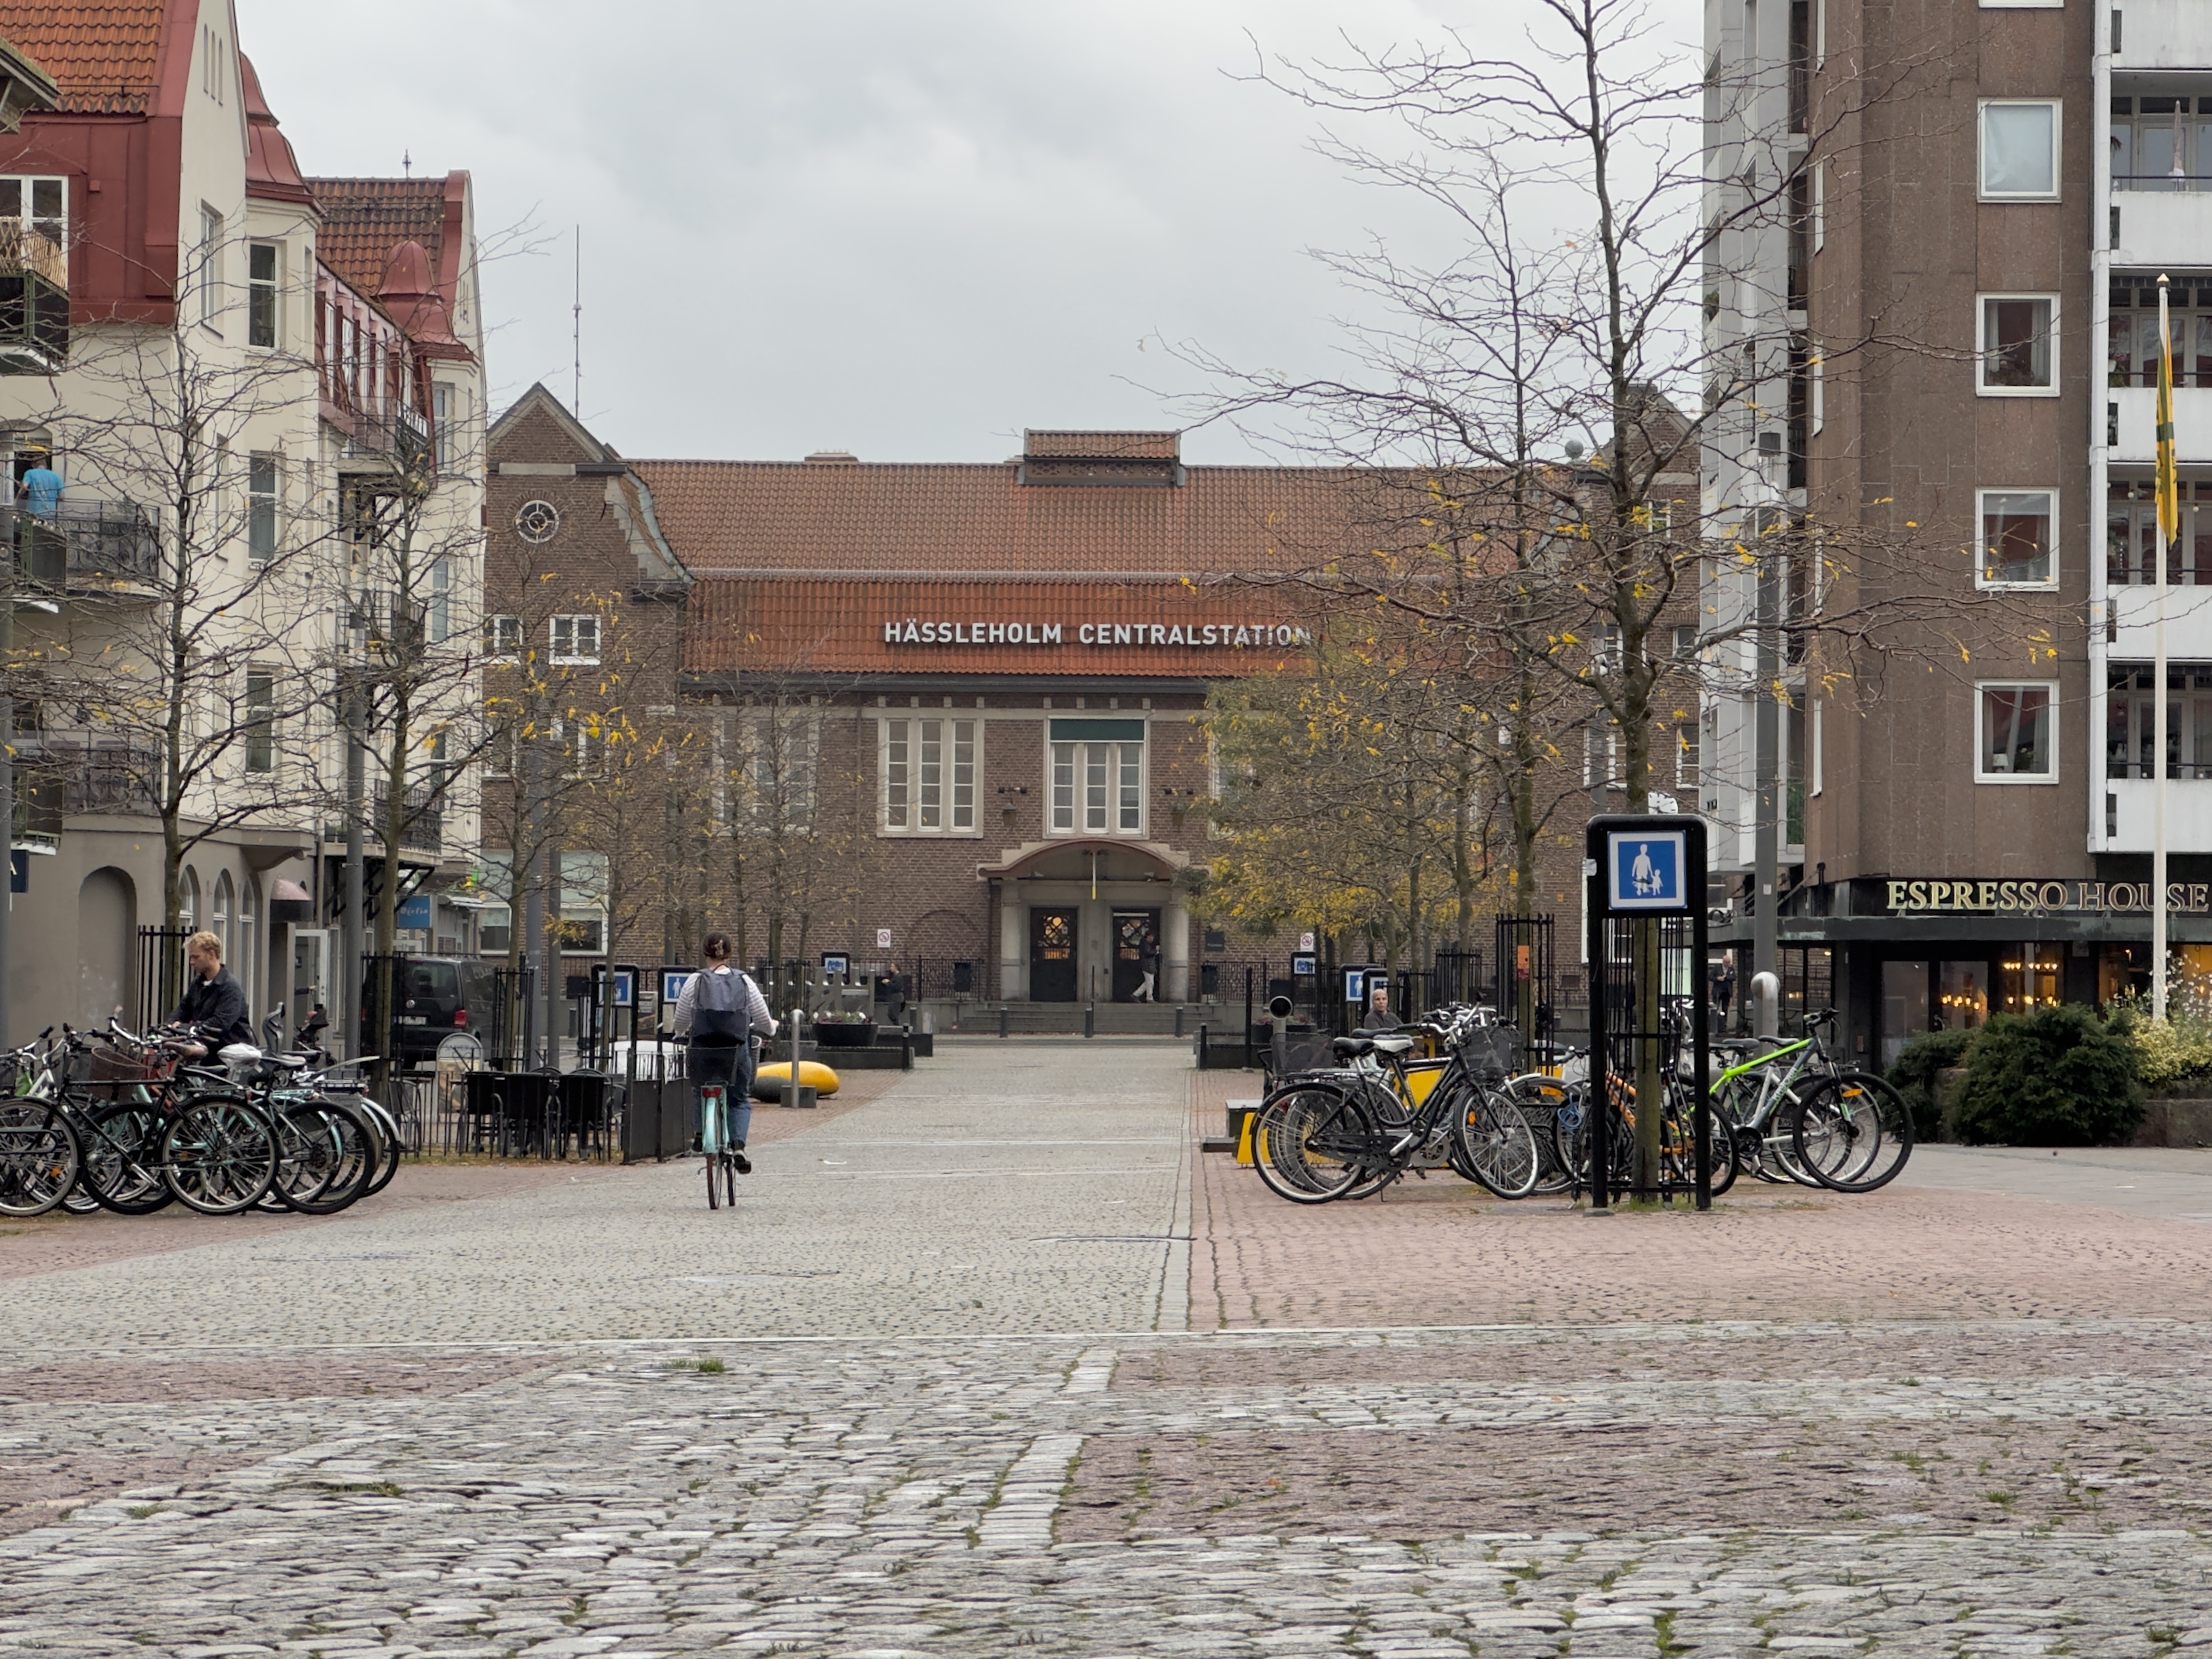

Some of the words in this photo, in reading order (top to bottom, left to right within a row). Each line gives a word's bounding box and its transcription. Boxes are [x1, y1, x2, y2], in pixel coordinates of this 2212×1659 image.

[885, 618, 1062, 644] HÄSSLEHOLM
[1079, 623, 1312, 646] CENTRALSTATION
[1886, 881, 2069, 911] ESPRESSO
[2078, 882, 2209, 913] HOUSE
